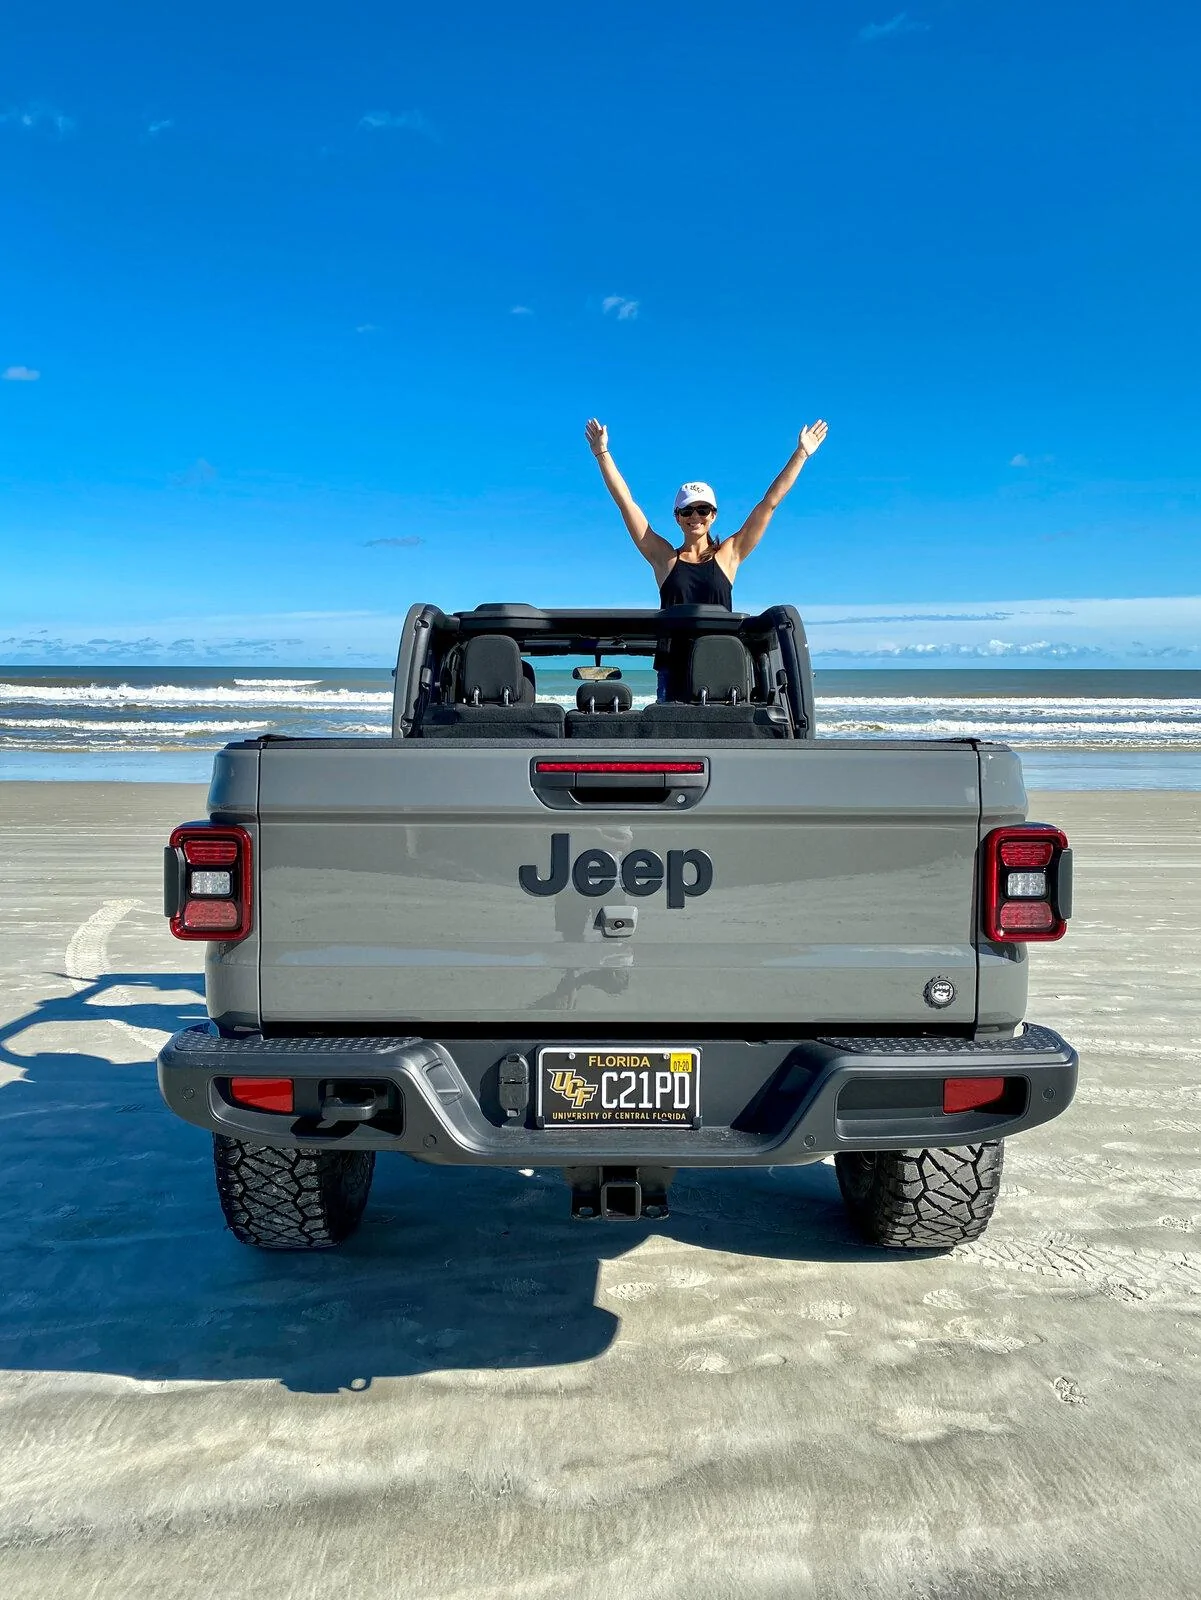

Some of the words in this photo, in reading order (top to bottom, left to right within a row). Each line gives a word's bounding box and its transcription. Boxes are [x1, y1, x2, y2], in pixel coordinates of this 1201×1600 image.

[518, 833, 713, 909] Jeep
[588, 1055, 650, 1067] FLORIDA
[673, 1060, 690, 1071] 07-20
[547, 1069, 598, 1109] UCF
[601, 1071, 690, 1109] C21PD
[552, 1112, 599, 1120] UNIVERSITY
[602, 1112, 613, 1120] OF
[615, 1112, 650, 1120] CENTRAL
[652, 1112, 687, 1120] FLORIDA
